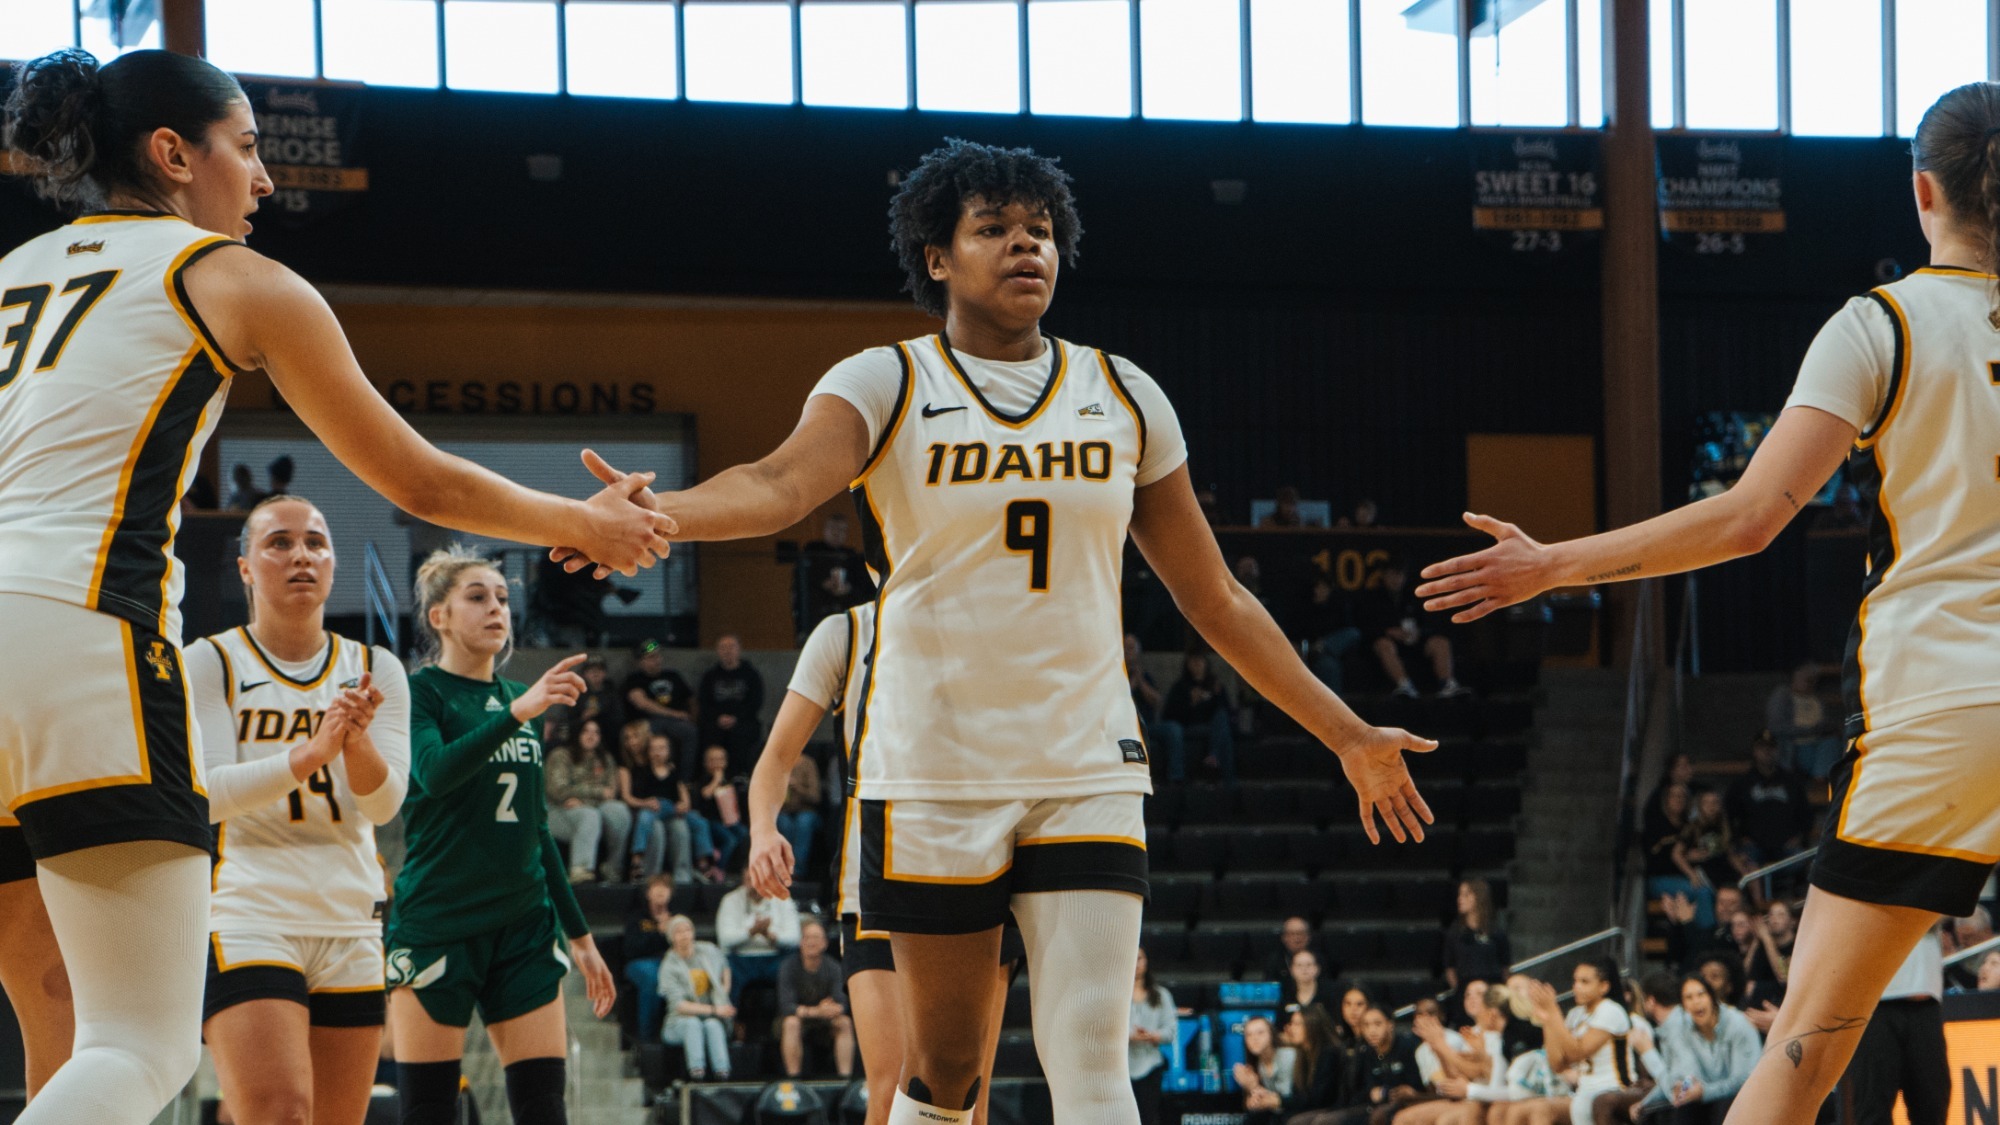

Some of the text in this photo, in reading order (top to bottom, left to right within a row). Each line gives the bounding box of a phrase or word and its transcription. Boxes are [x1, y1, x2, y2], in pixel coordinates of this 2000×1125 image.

[1475, 171, 1597, 195] SWEET 16
[0, 269, 123, 391] 37
[925, 440, 1112, 486] IDAHO
[1004, 498, 1051, 592] 9
[238, 708, 326, 743] IDA
[495, 772, 519, 822] 2
